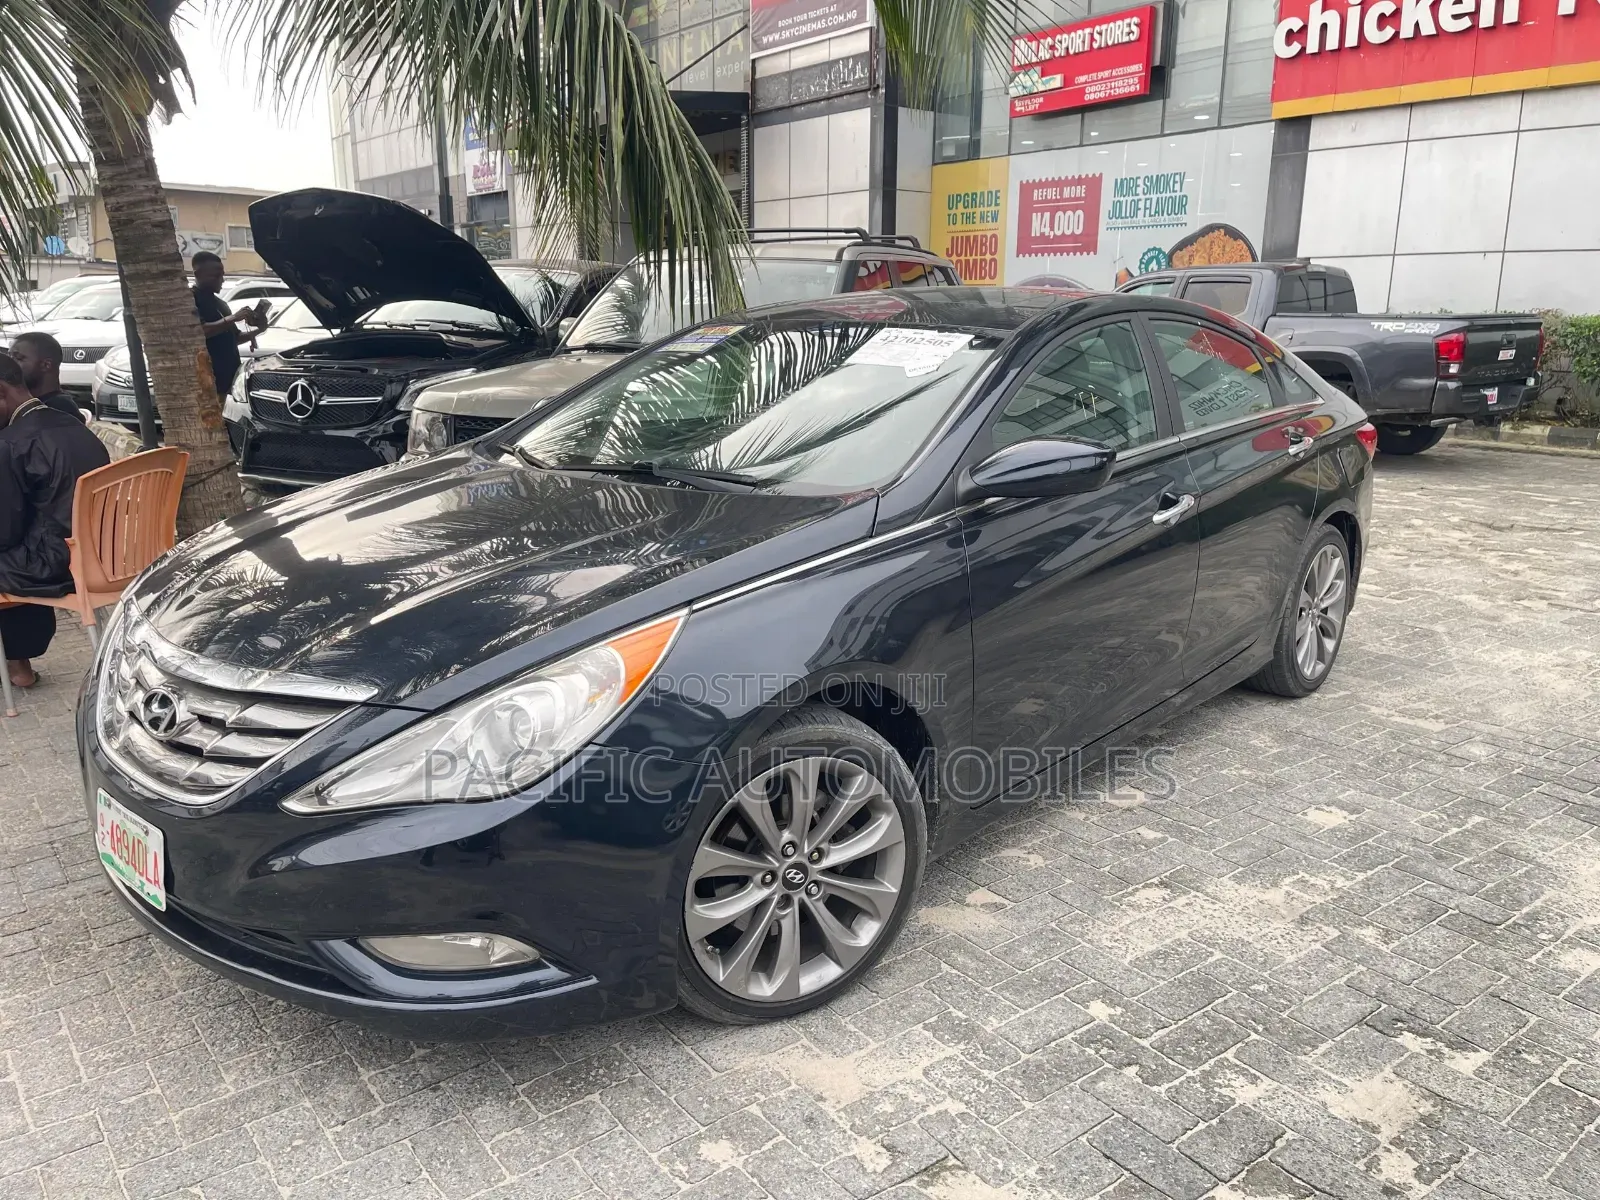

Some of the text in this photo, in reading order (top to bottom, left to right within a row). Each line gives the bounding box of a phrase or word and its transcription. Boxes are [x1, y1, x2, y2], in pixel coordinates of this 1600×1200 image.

[762, 10, 858, 44] WWW.SKYCINEMAS.COM.NG
[778, 18, 792, 27] BOOK
[793, 14, 808, 23] YOUR
[808, 7, 829, 17] TICKETS
[1055, 27, 1093, 57] SPORT
[1092, 16, 1141, 49] STORES
[1273, 0, 1519, 58] chicken
[642, 16, 744, 78] INEMA
[685, 67, 709, 84] level
[1074, 63, 1143, 84] COMPLETE SPORT ACCESSORIES
[1084, 84, 1140, 101] 08067136661
[1085, 77, 1139, 94] 08023118295
[1025, 103, 1040, 111] LEFT
[1033, 185, 1086, 200] REFUEL MORE
[1114, 171, 1186, 198] MORE SMOKEY
[947, 189, 1001, 210] UPGRADE
[1108, 194, 1188, 220] JOLLOF FLAVOUR
[947, 209, 1000, 226] TO THE NEW
[945, 233, 999, 258] JUMBO
[1370, 321, 1406, 333] TRD
